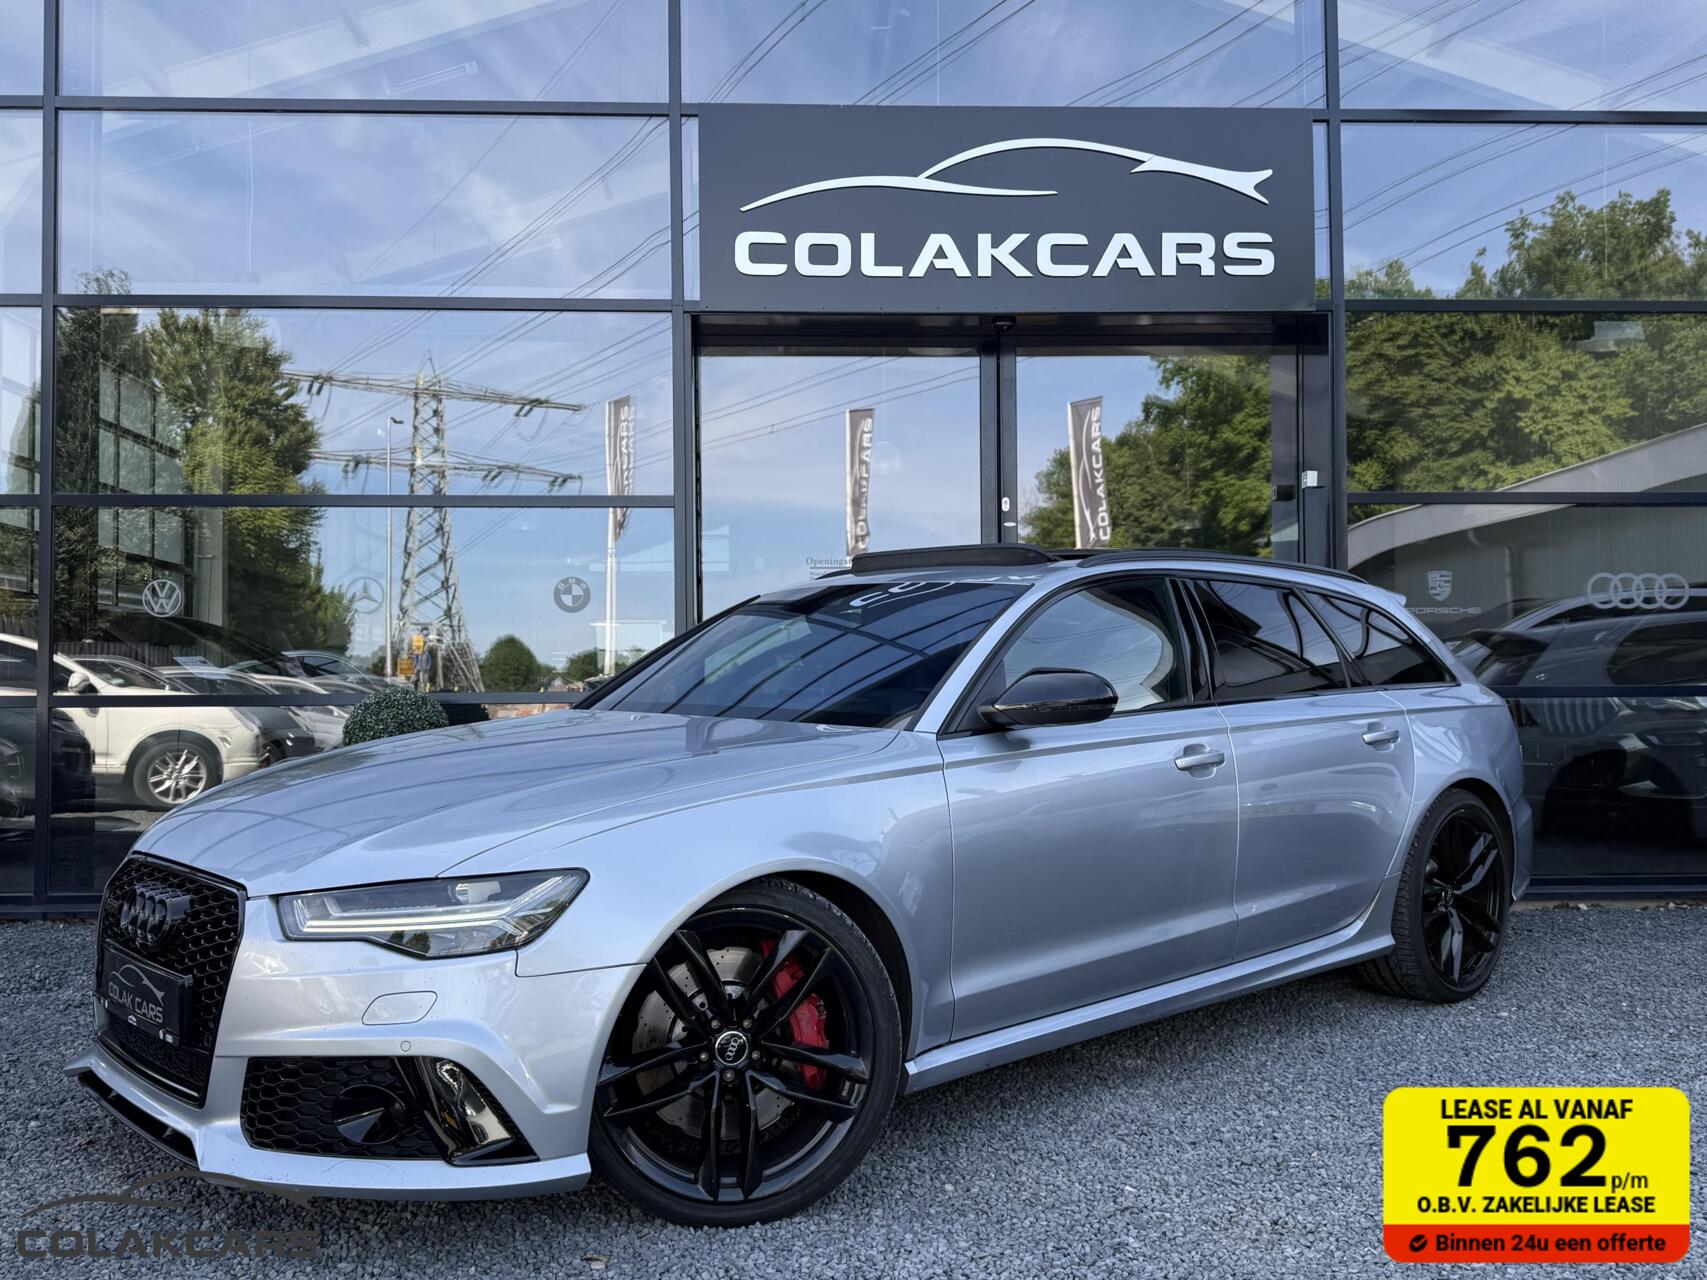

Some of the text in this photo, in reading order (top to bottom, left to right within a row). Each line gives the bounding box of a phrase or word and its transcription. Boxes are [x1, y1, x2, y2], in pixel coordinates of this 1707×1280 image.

[734, 231, 1275, 278] COLAKCARS
[1091, 405, 1111, 541] COLAKCARS
[108, 981, 163, 1023] COLAK CARS
